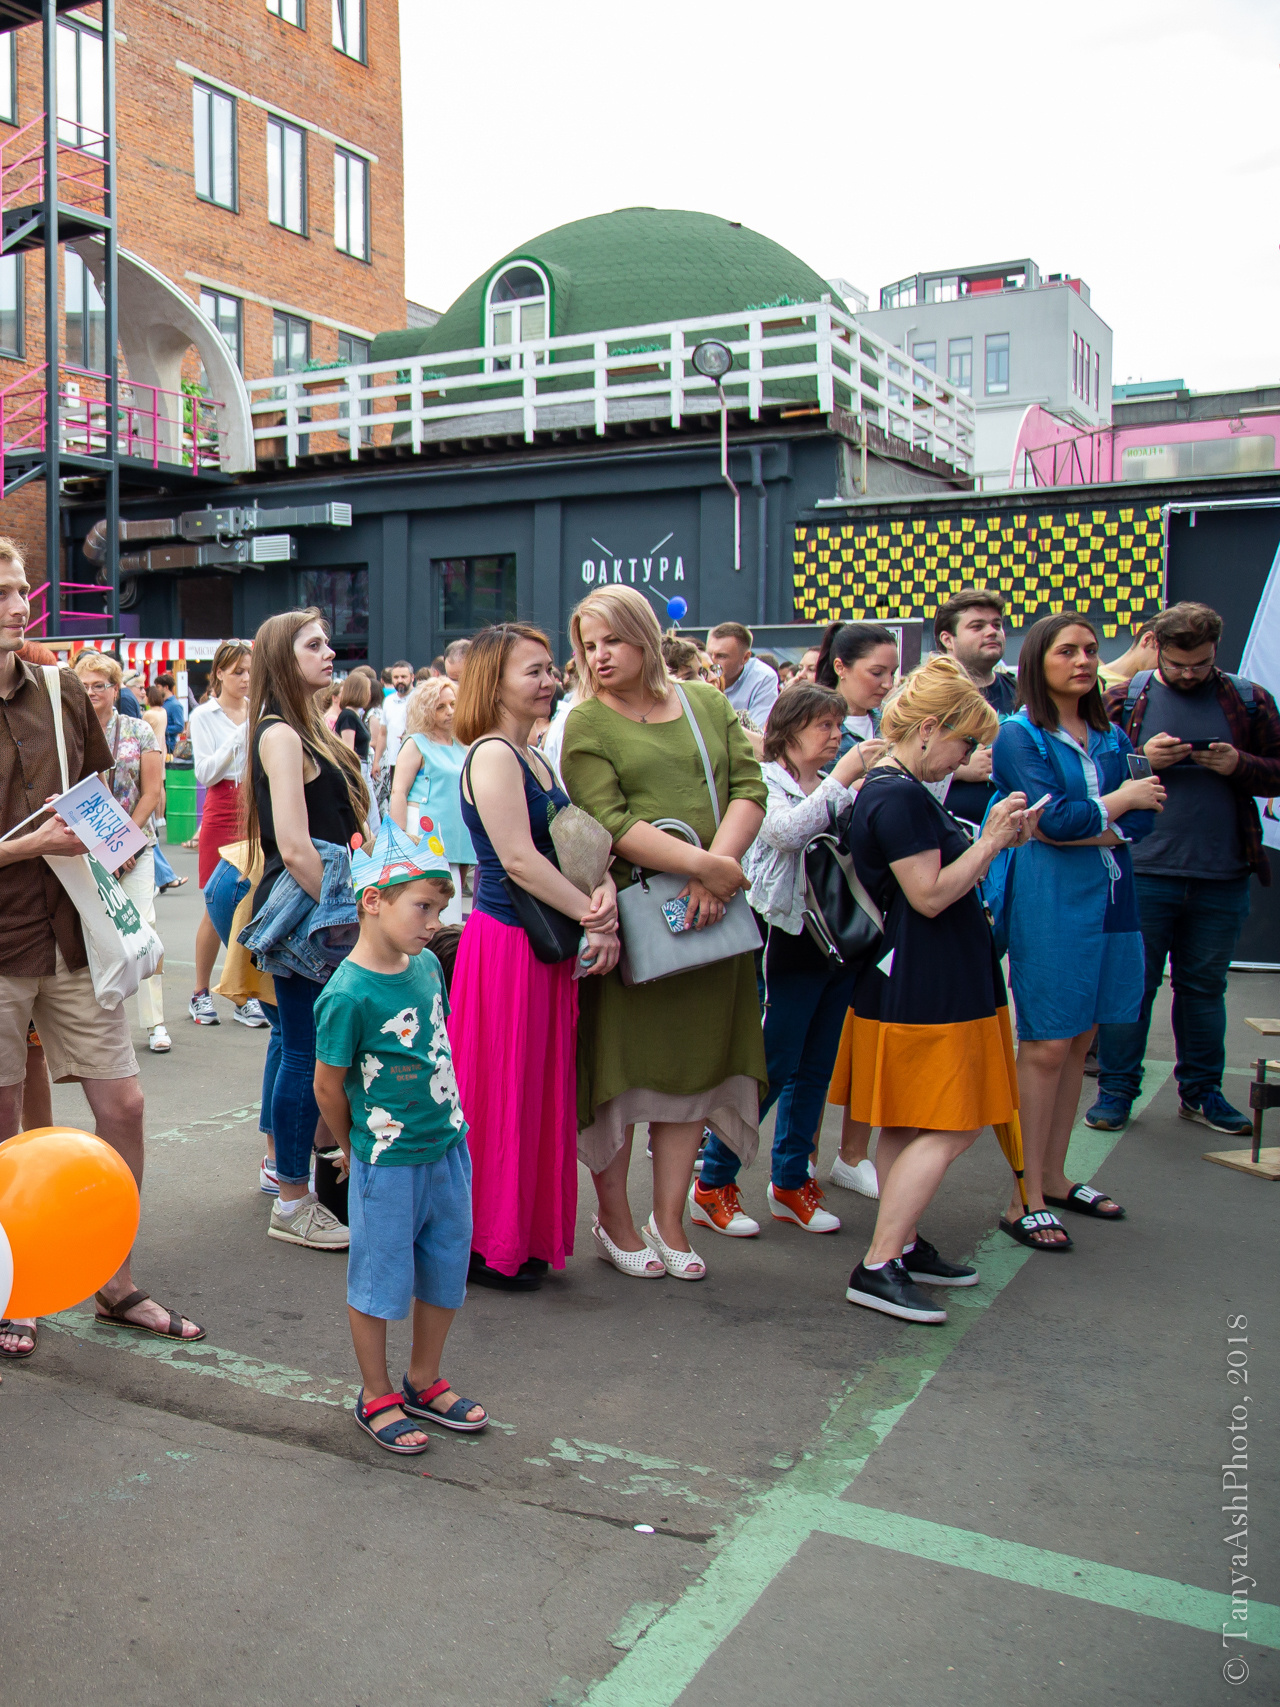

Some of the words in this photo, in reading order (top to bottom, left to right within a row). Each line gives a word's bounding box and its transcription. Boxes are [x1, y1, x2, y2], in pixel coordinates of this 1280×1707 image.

[581, 556, 685, 584] ФАКТУРА
[76, 799, 124, 853] FRANÇAIS
[90, 792, 131, 839] INSTITUT
[390, 1063, 422, 1074] ATLANTIC
